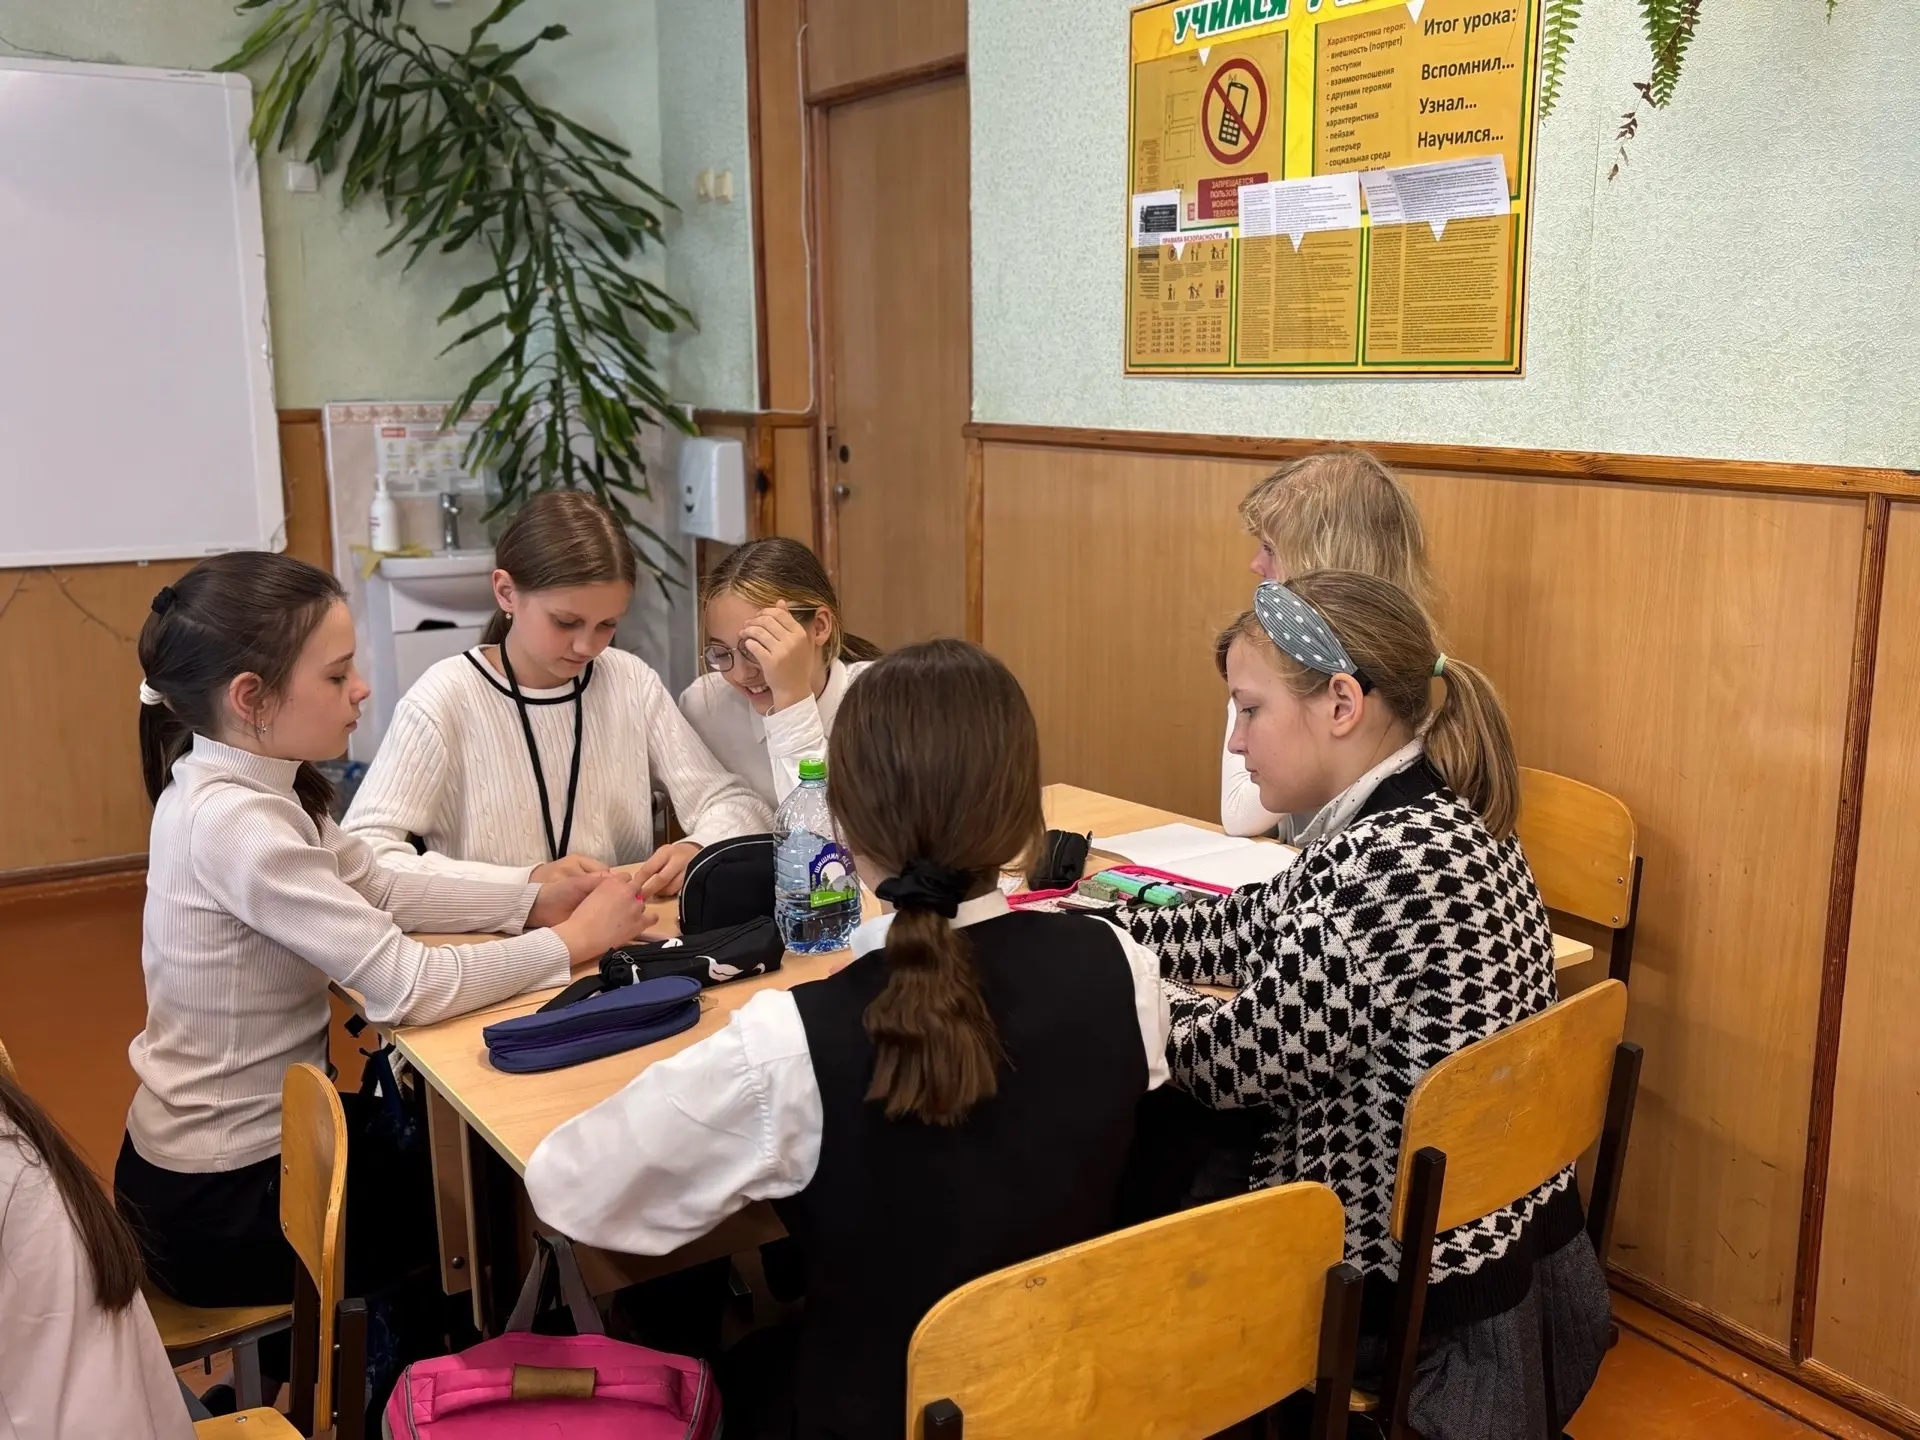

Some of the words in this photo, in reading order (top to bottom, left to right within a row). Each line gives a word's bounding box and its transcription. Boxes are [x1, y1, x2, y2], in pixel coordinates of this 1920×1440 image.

[1424, 18, 1459, 36] Итог
[1463, 8, 1516, 34] урока:
[1327, 27, 1381, 46] Характеристика
[1383, 22, 1406, 35] героя:
[1331, 45, 1368, 59] внешность
[1369, 35, 1403, 52] (портрет)
[1330, 60, 1361, 73] поступки
[1421, 57, 1515, 80] Вспомнил...
[1330, 67, 1395, 86] взаимоотношения
[1331, 87, 1360, 101] другими
[1362, 82, 1392, 95] героями
[1330, 102, 1358, 115] речевая
[1419, 97, 1477, 114] Узнал...
[1326, 111, 1379, 128] характеристика
[1330, 129, 1355, 140] пейзаж
[1417, 128, 1504, 150] Научился...
[1329, 142, 1361, 153] интерьер
[1329, 154, 1369, 167] социальная
[1370, 151, 1391, 162] среда
[1211, 177, 1254, 189] ЗАПРЕЩАЕТСЯ
[814, 851, 840, 874] ШИШКИН
